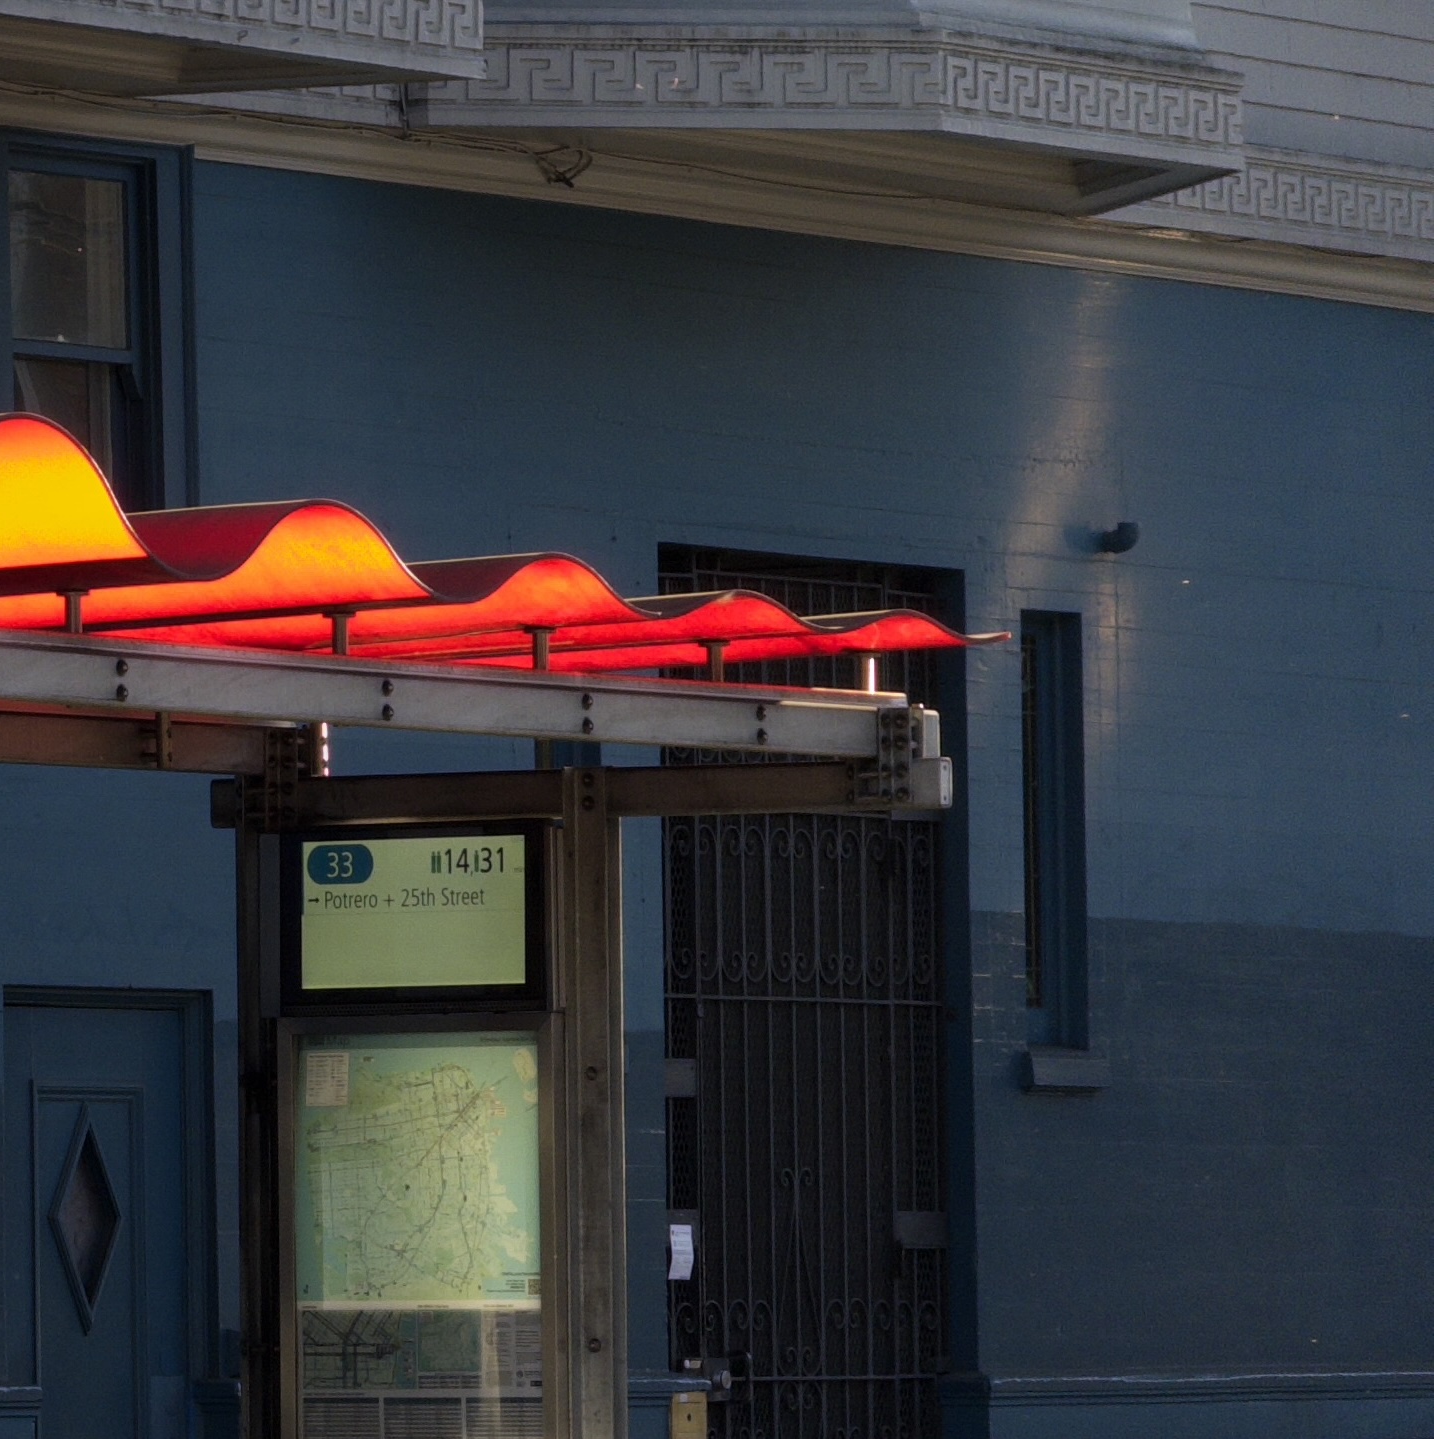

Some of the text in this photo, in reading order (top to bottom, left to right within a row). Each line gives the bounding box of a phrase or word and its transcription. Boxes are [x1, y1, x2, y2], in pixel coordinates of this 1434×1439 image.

[326, 851, 354, 879] 33
[480, 846, 505, 873] 31
[324, 891, 378, 910] Potrero
[400, 887, 436, 908] 25th
[441, 886, 485, 907] Street
